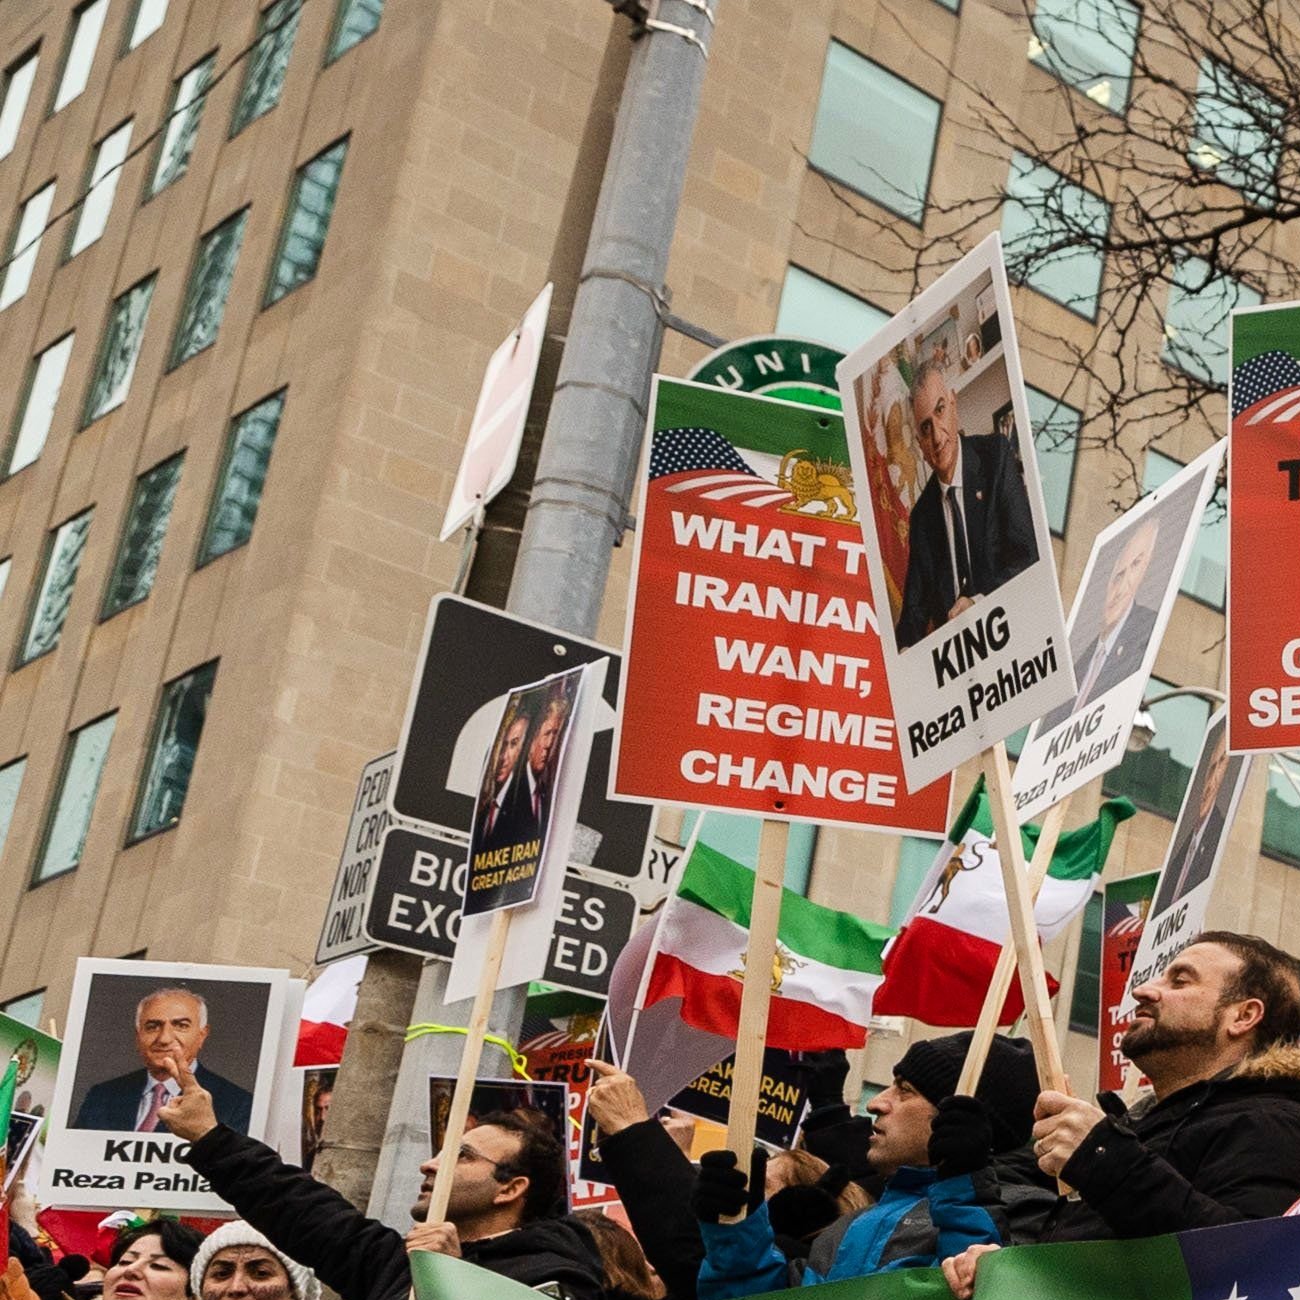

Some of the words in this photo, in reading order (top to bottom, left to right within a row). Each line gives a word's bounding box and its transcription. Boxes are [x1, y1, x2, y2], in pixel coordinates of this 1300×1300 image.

[670, 511, 826, 561] WHAT
[715, 637, 872, 698] WANT,
[932, 606, 1011, 689] KING
[697, 694, 895, 751] REGIME
[908, 702, 965, 759] Reza
[969, 638, 1058, 723] Pahlavi
[1043, 704, 1105, 767] KING
[680, 750, 897, 808] CHANGE
[1014, 780, 1047, 813] eza
[1051, 725, 1121, 788] Pahlavi
[338, 856, 376, 902] NOR
[472, 870, 505, 891] GREAT
[505, 862, 536, 883] AGAIN
[474, 847, 510, 871] MAKE
[511, 839, 540, 863] IRAN
[1152, 903, 1189, 950] KING
[534, 1063, 590, 1083] TRU
[760, 1075, 800, 1106] RAN
[688, 1077, 732, 1101] GREA
[757, 1098, 794, 1125] GAIN
[52, 1168, 126, 1190] Reza
[134, 1171, 216, 1194] Pahla
